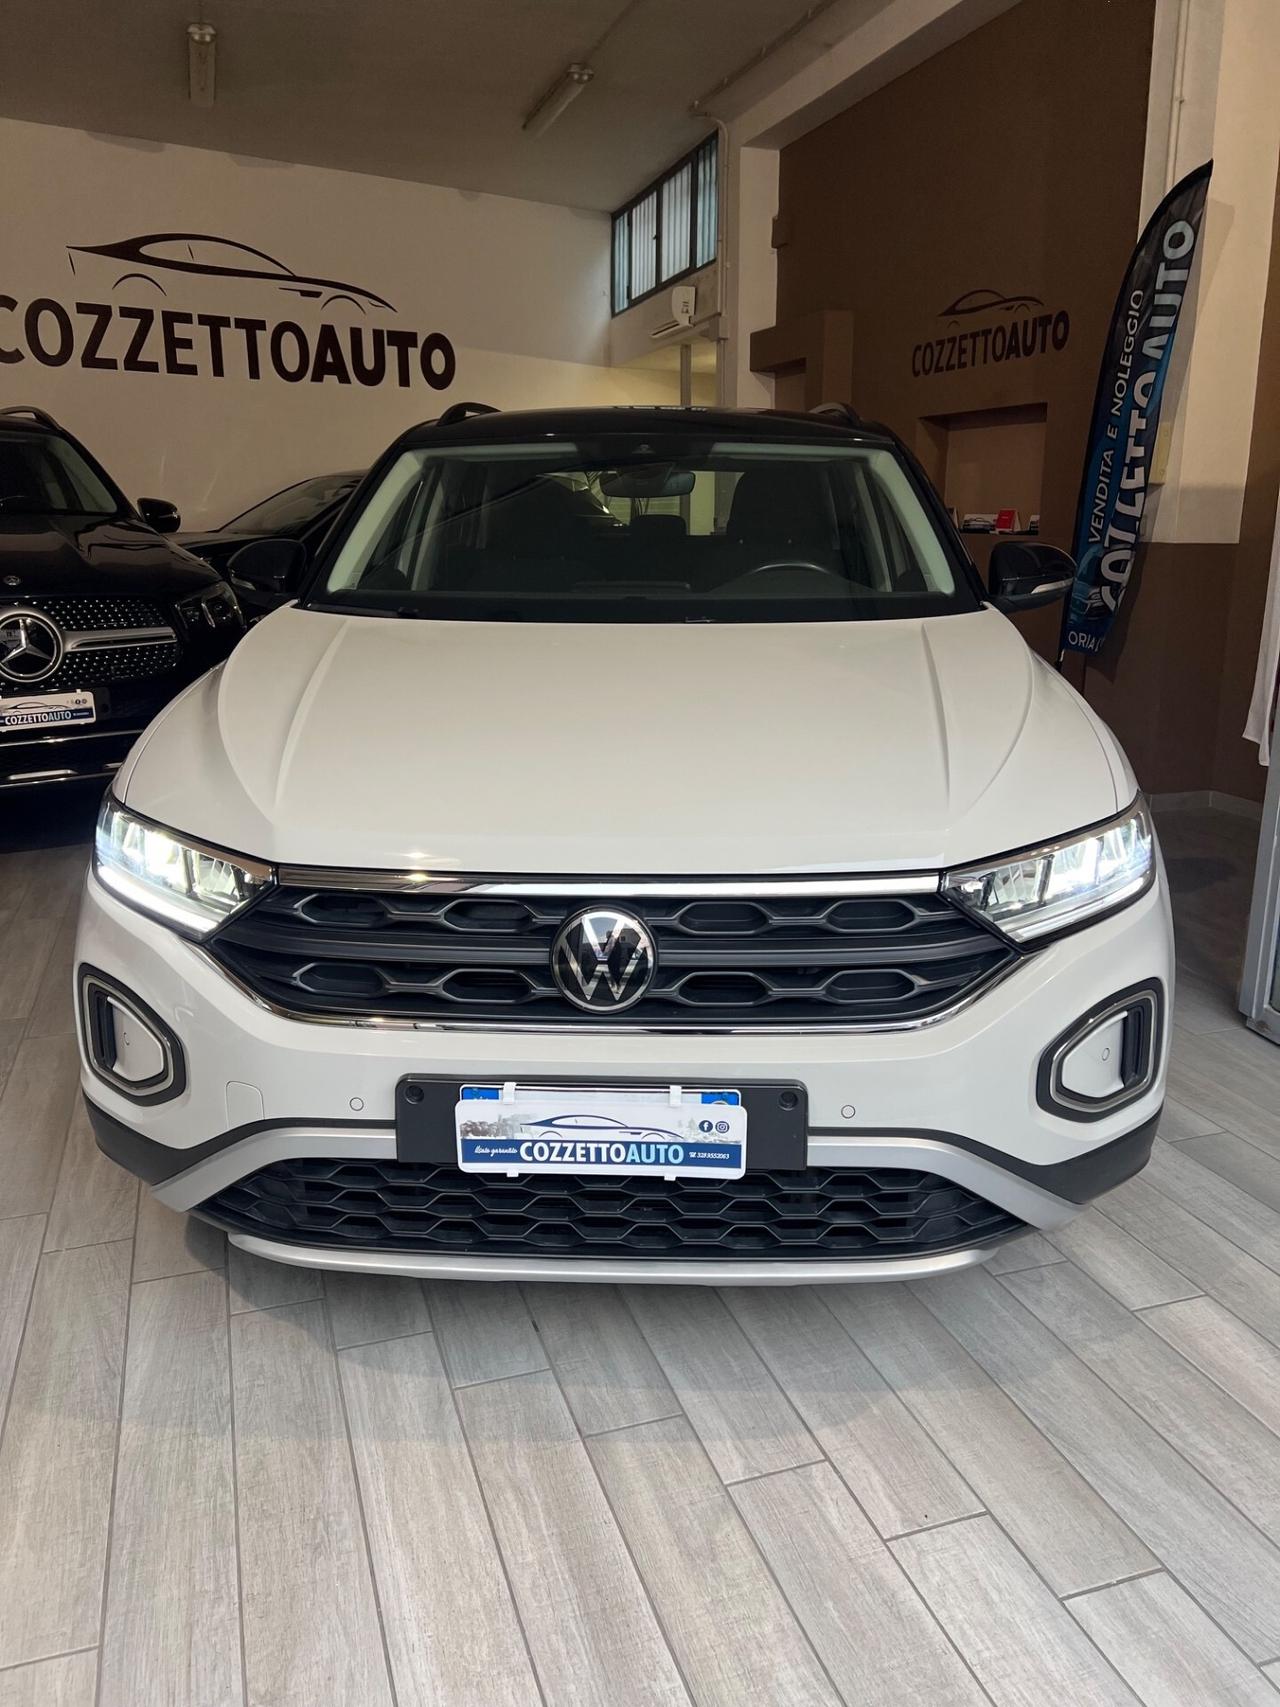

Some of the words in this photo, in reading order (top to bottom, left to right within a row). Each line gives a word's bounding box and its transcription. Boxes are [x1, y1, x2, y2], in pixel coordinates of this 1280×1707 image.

[0, 295, 456, 391] COZZETTOAUTO
[912, 310, 1070, 378] COZZETTOAUTO
[1111, 290, 1144, 416] NOLEGGIO
[1107, 424, 1118, 440] E
[1088, 450, 1114, 544] VENDITA
[5, 711, 72, 725] COZZETTOAUTO
[520, 1141, 684, 1164] COZZETTOAUTO
